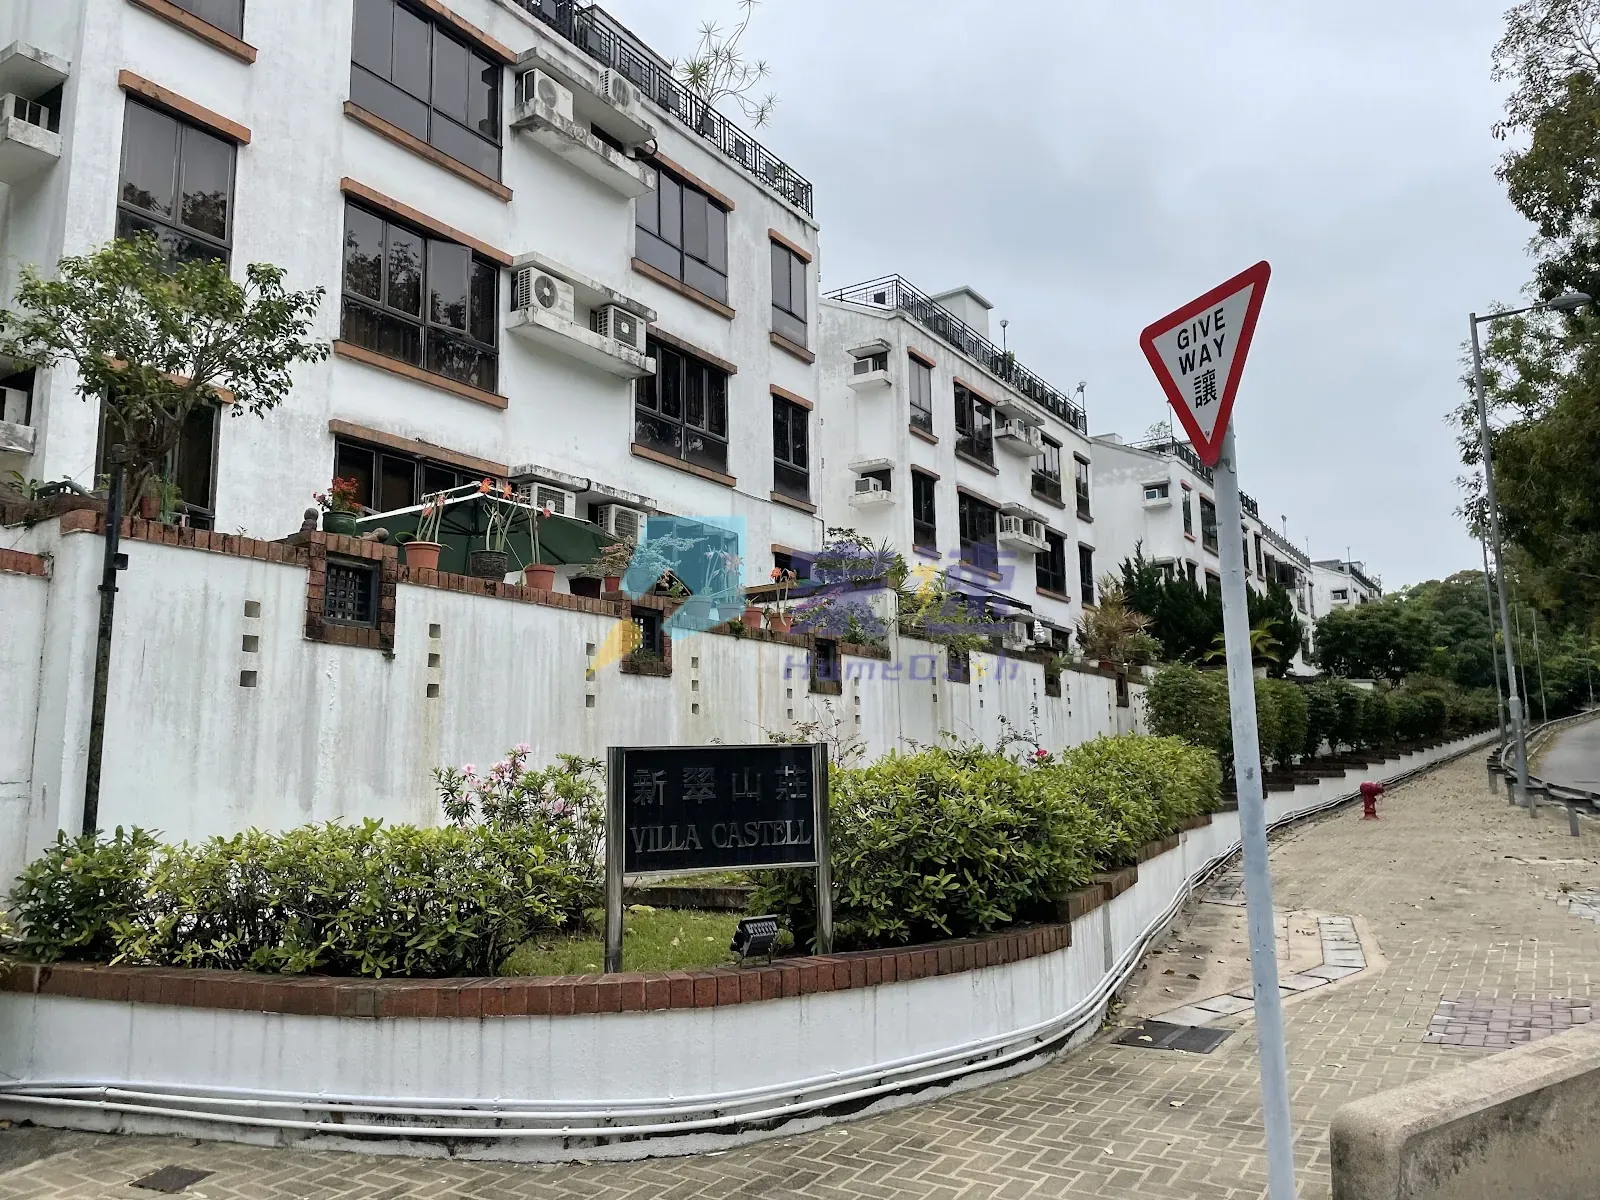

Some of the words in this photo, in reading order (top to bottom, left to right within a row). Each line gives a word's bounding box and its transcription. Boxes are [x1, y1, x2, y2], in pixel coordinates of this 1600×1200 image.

[1177, 307, 1226, 350] GIVE
[1178, 333, 1226, 375] WAY
[1193, 368, 1218, 408] 讓
[633, 765, 808, 806] 新翠山莊
[629, 824, 703, 853] VILLA
[711, 819, 812, 849] CASTELL
